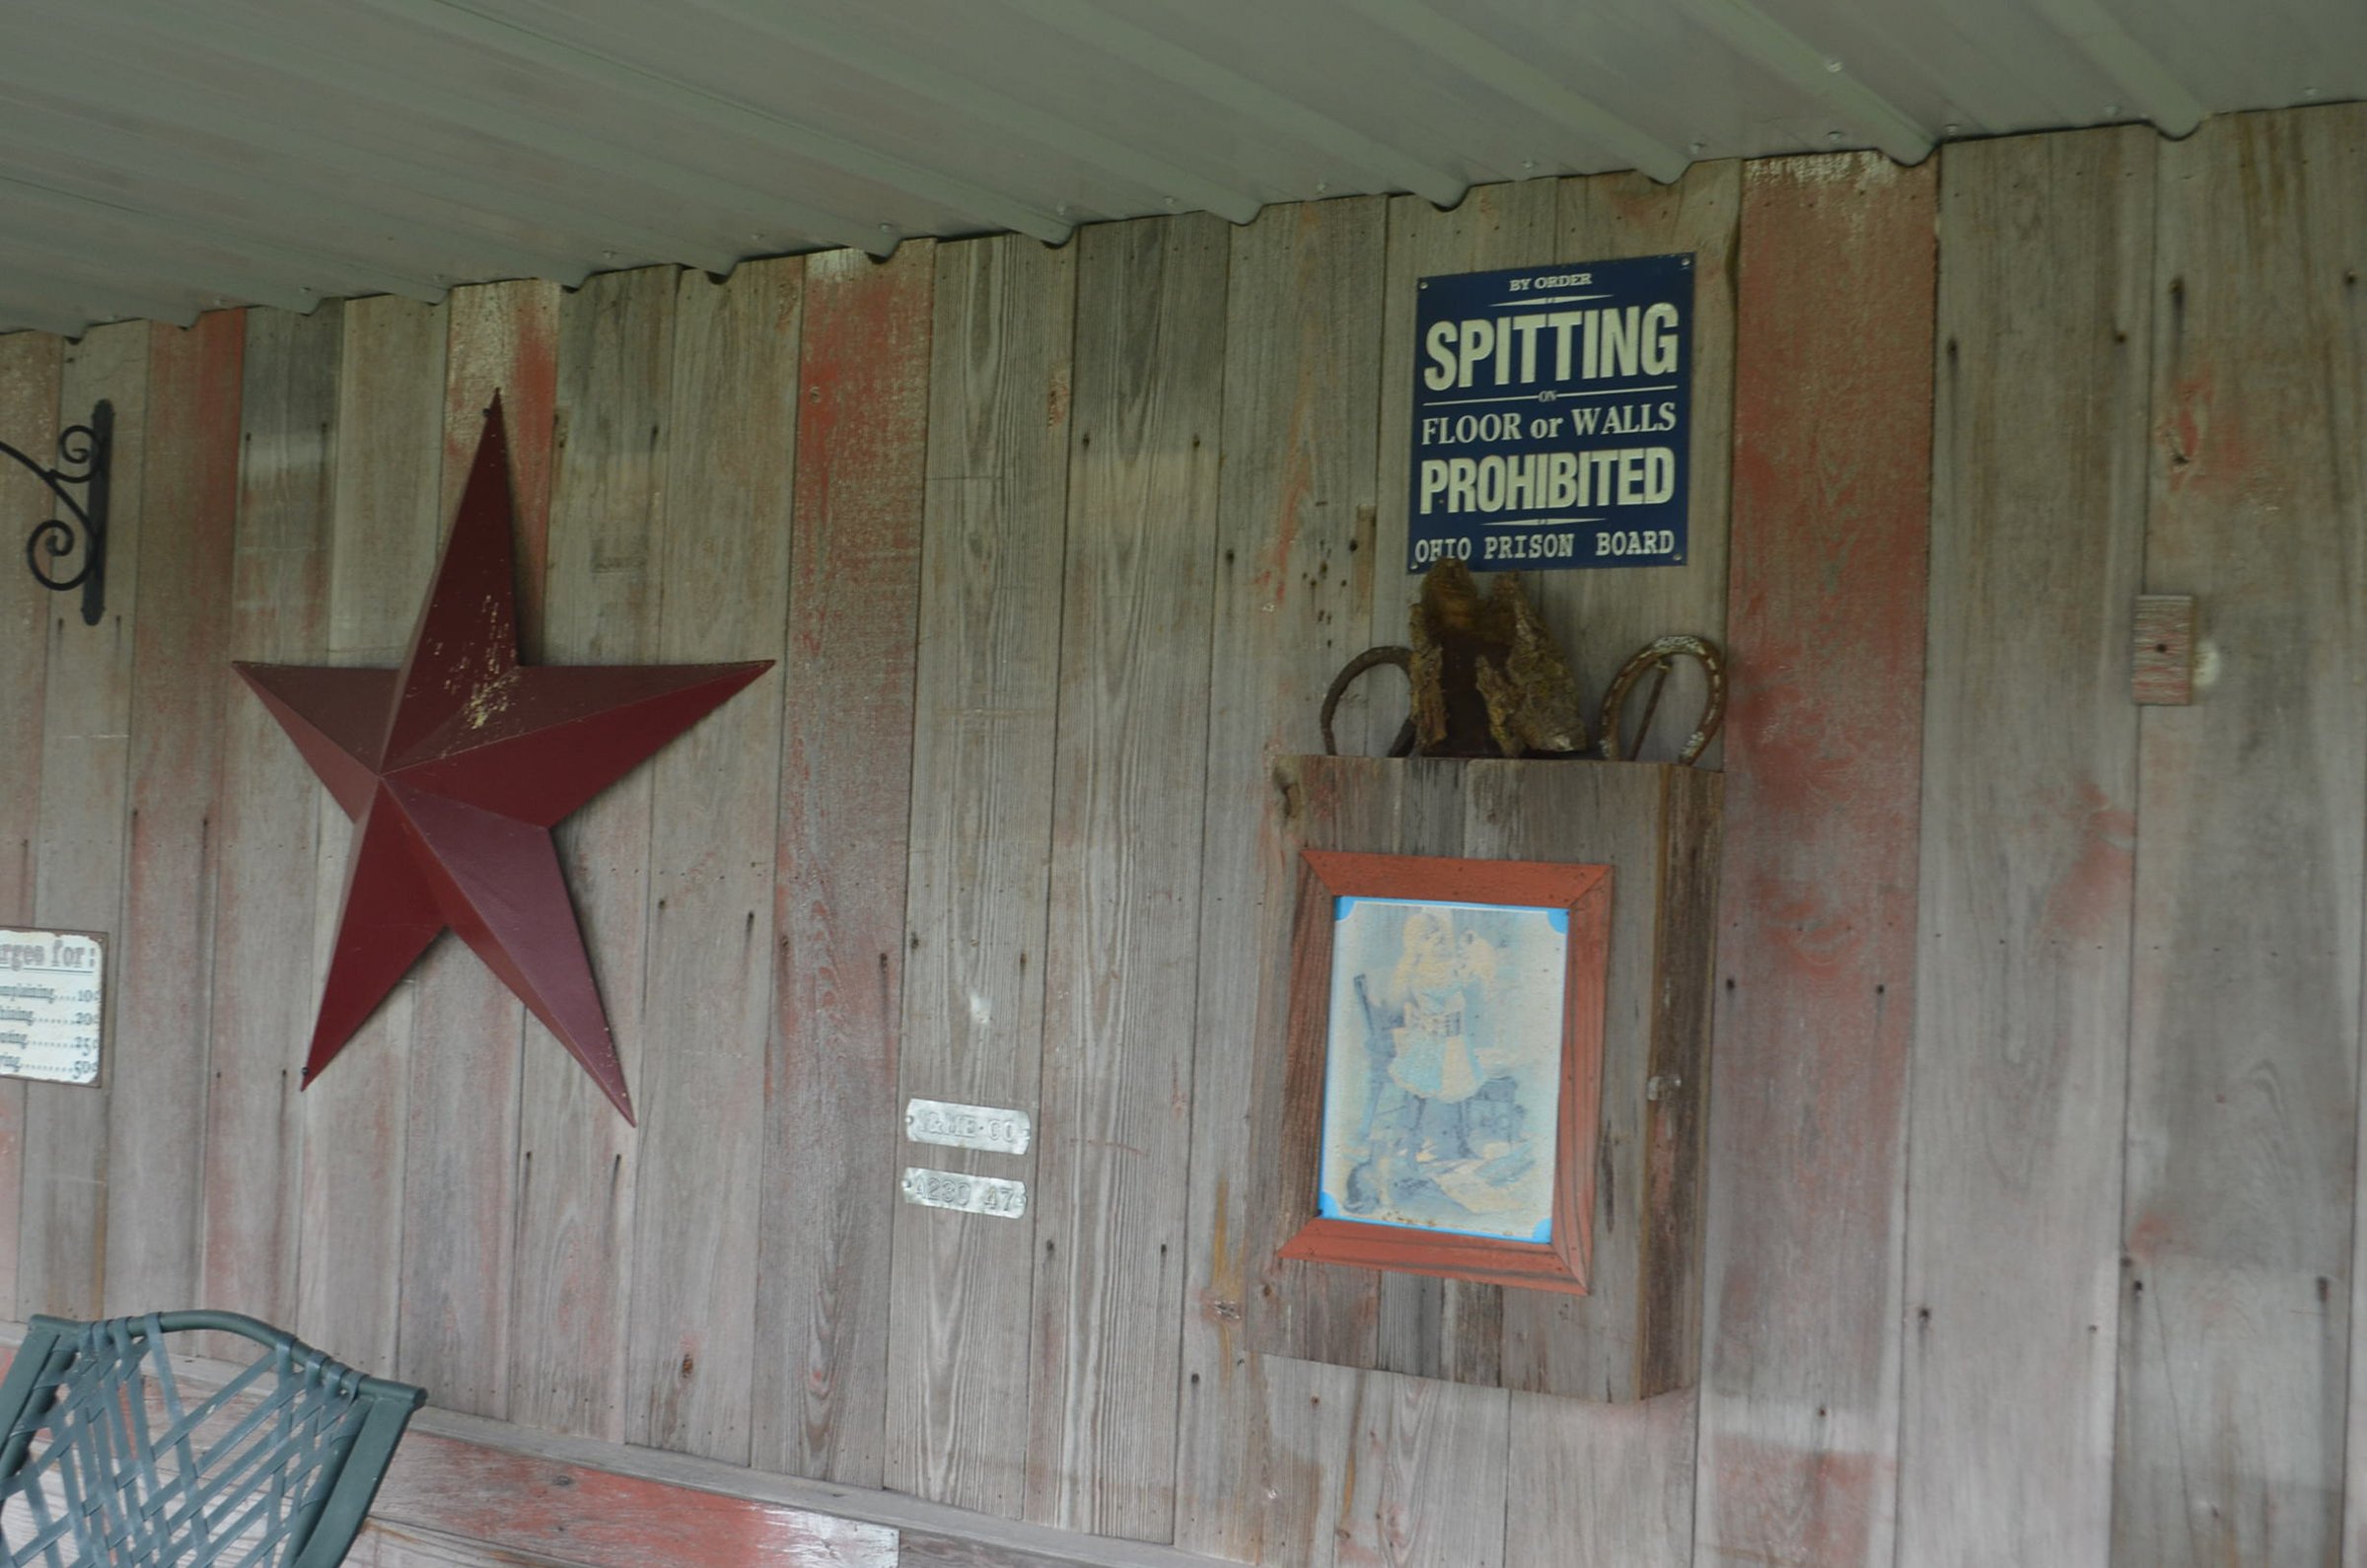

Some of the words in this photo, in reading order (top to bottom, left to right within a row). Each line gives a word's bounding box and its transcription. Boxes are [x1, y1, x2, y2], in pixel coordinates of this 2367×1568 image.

[1509, 278, 1531, 292] BY
[1535, 272, 1593, 290] ORDER
[1423, 302, 1680, 391] SPITTING
[1421, 412, 1522, 446] FLOOR
[1530, 415, 1563, 439] or
[1571, 401, 1677, 436] WALLS
[1420, 447, 1676, 515] PROHIBITED
[1415, 536, 1471, 563] OHIO
[1484, 534, 1574, 559] PRISON
[1596, 530, 1675, 556] BOARD
